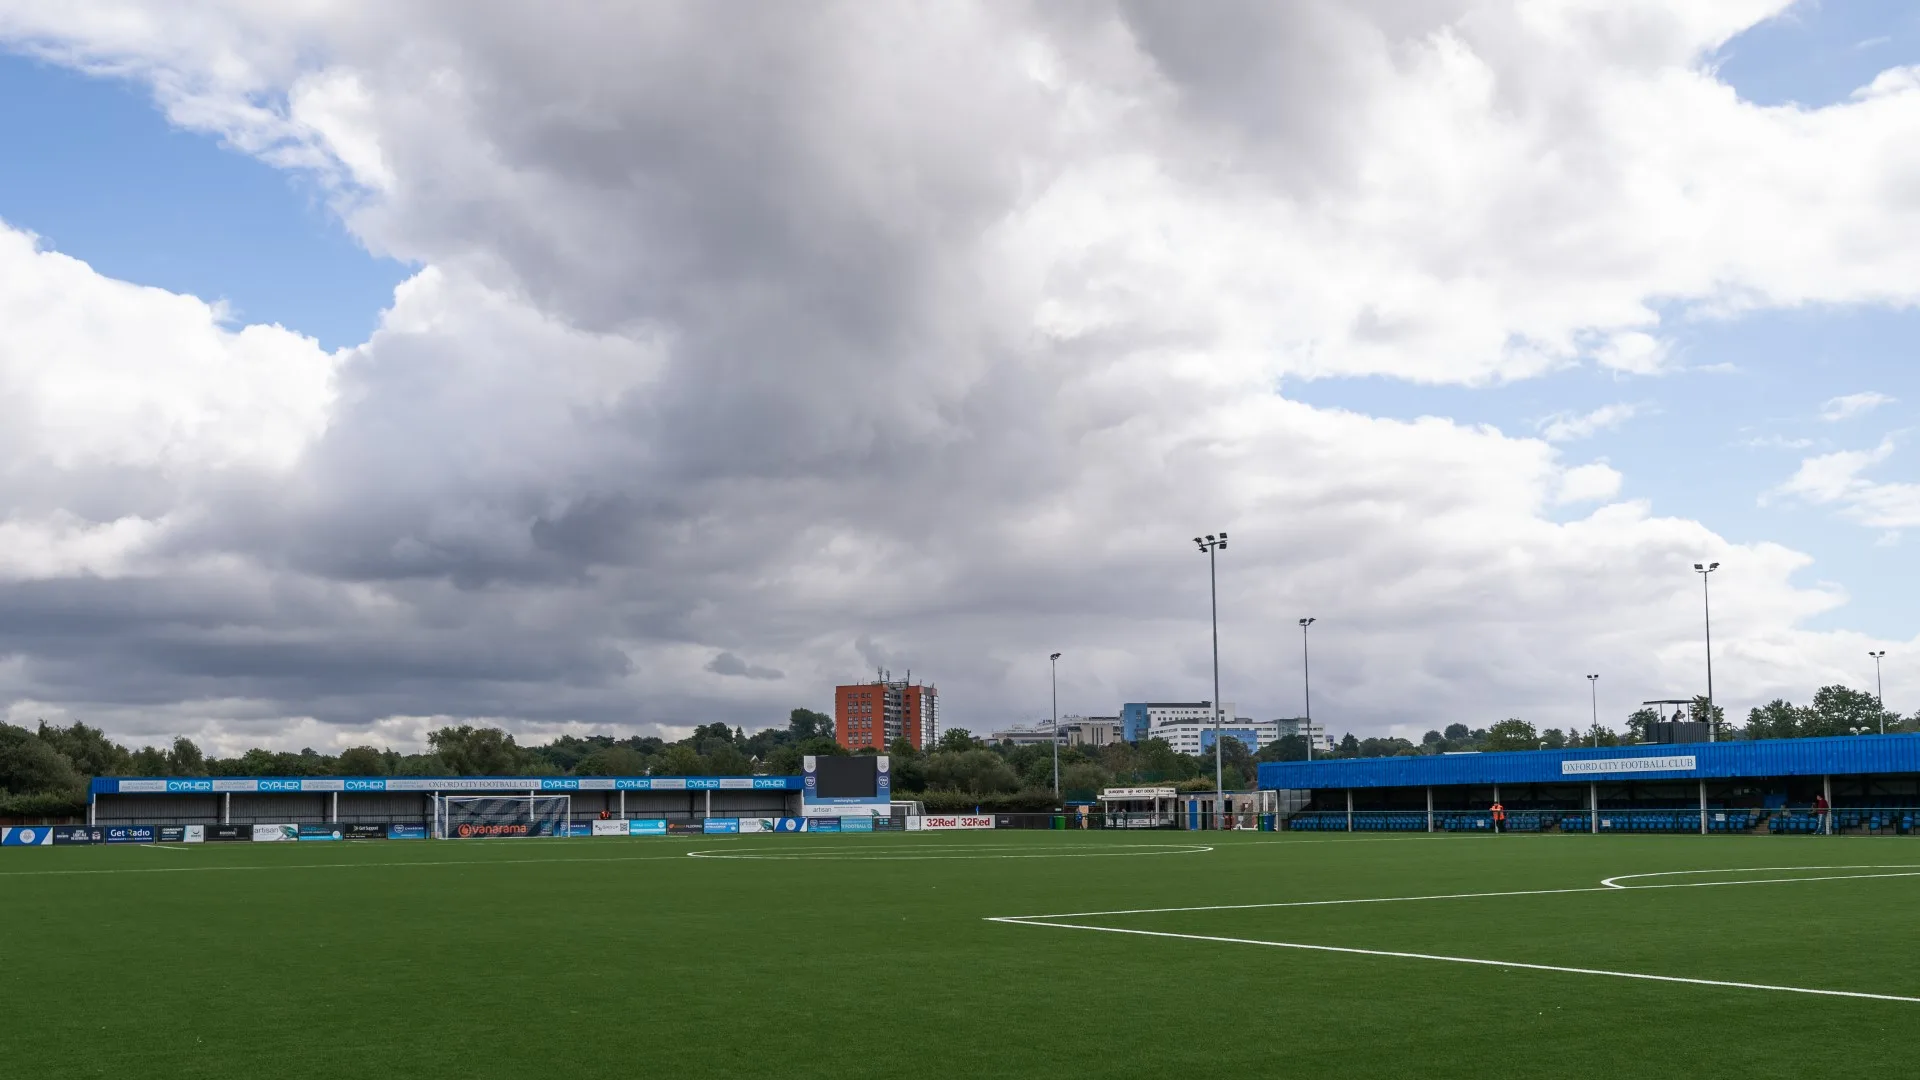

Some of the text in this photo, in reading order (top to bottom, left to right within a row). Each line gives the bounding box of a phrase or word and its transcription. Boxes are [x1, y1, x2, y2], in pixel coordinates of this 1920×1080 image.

[1563, 758, 1693, 772] OXFORD CITY FOOTBALL CLUB
[168, 781, 210, 791] CYPHER
[259, 781, 300, 790] CYPHER
[346, 781, 384, 790] CYPHER
[543, 780, 577, 789] CYPHER
[617, 780, 650, 788] CYPHER
[687, 780, 719, 788] CYPHER
[754, 780, 785, 788] CYPHER
[926, 818, 956, 827] 32Red
[961, 817, 990, 827] 32Red
[110, 828, 150, 837] Get Radio
[471, 824, 527, 834] vanarama
